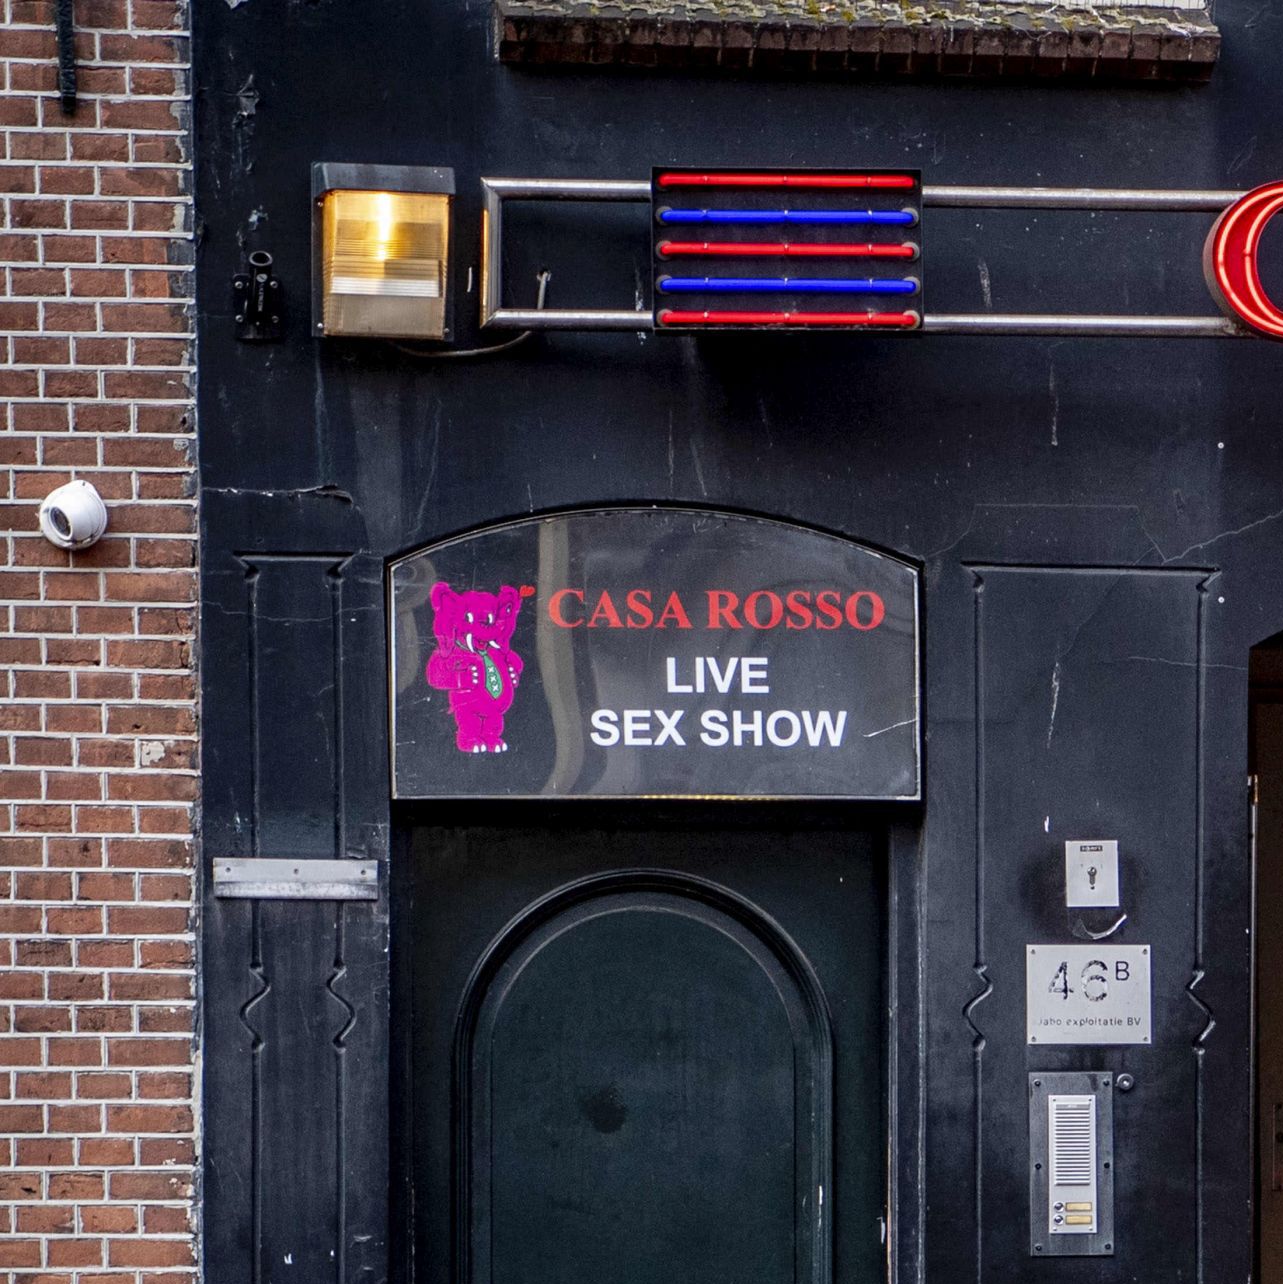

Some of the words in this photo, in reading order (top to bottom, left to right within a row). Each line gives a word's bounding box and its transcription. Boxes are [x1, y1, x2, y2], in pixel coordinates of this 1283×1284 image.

[548, 588, 693, 630] CASA
[705, 590, 885, 631] ROSSO
[666, 657, 769, 693] LIVE
[590, 709, 686, 747] SEX
[700, 709, 847, 747] SHOW
[1066, 1016, 1123, 1029] exploitatie
[1127, 1017, 1141, 1026] BV
